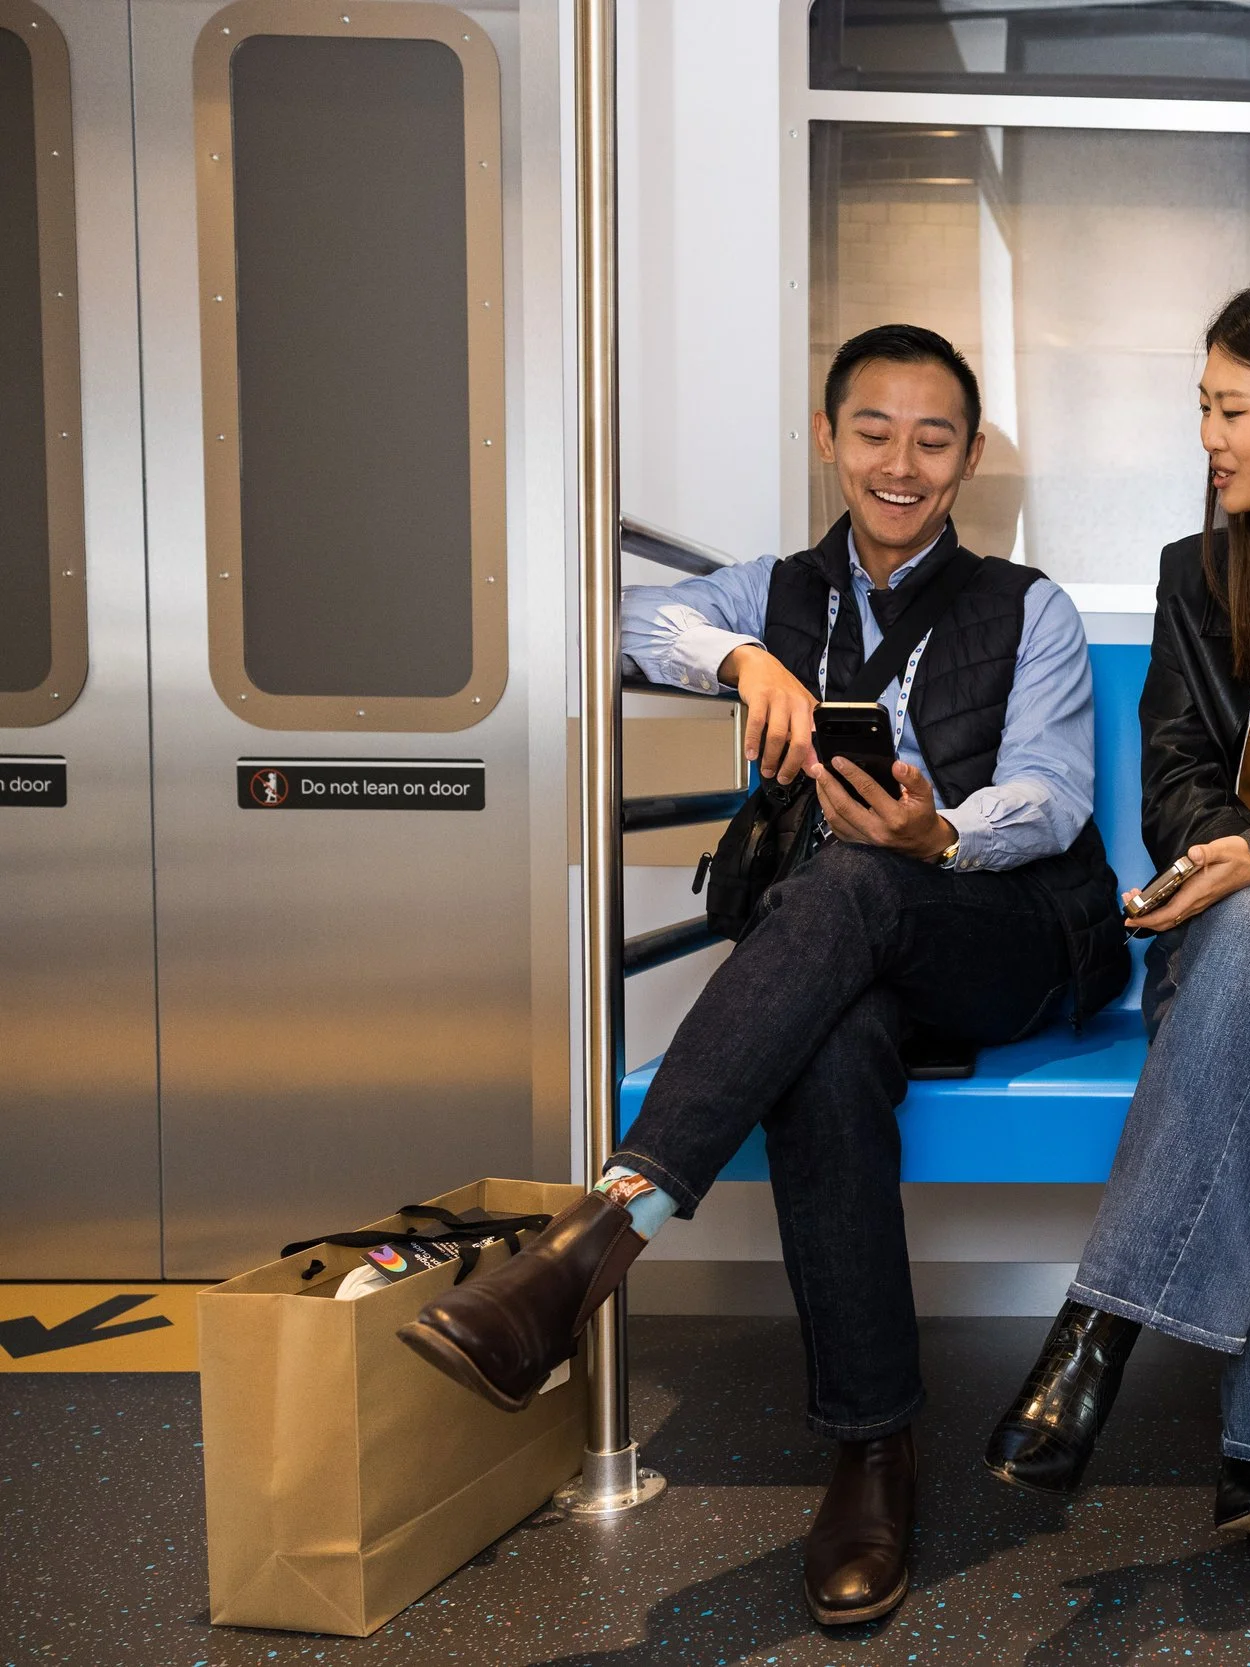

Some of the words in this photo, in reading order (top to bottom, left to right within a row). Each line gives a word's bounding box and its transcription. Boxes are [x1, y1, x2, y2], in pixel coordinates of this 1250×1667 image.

[10, 777, 51, 792] door
[302, 779, 325, 794] Do
[331, 781, 358, 794] not
[364, 780, 398, 795] lean
[403, 784, 424, 795] on
[430, 781, 470, 795] door
